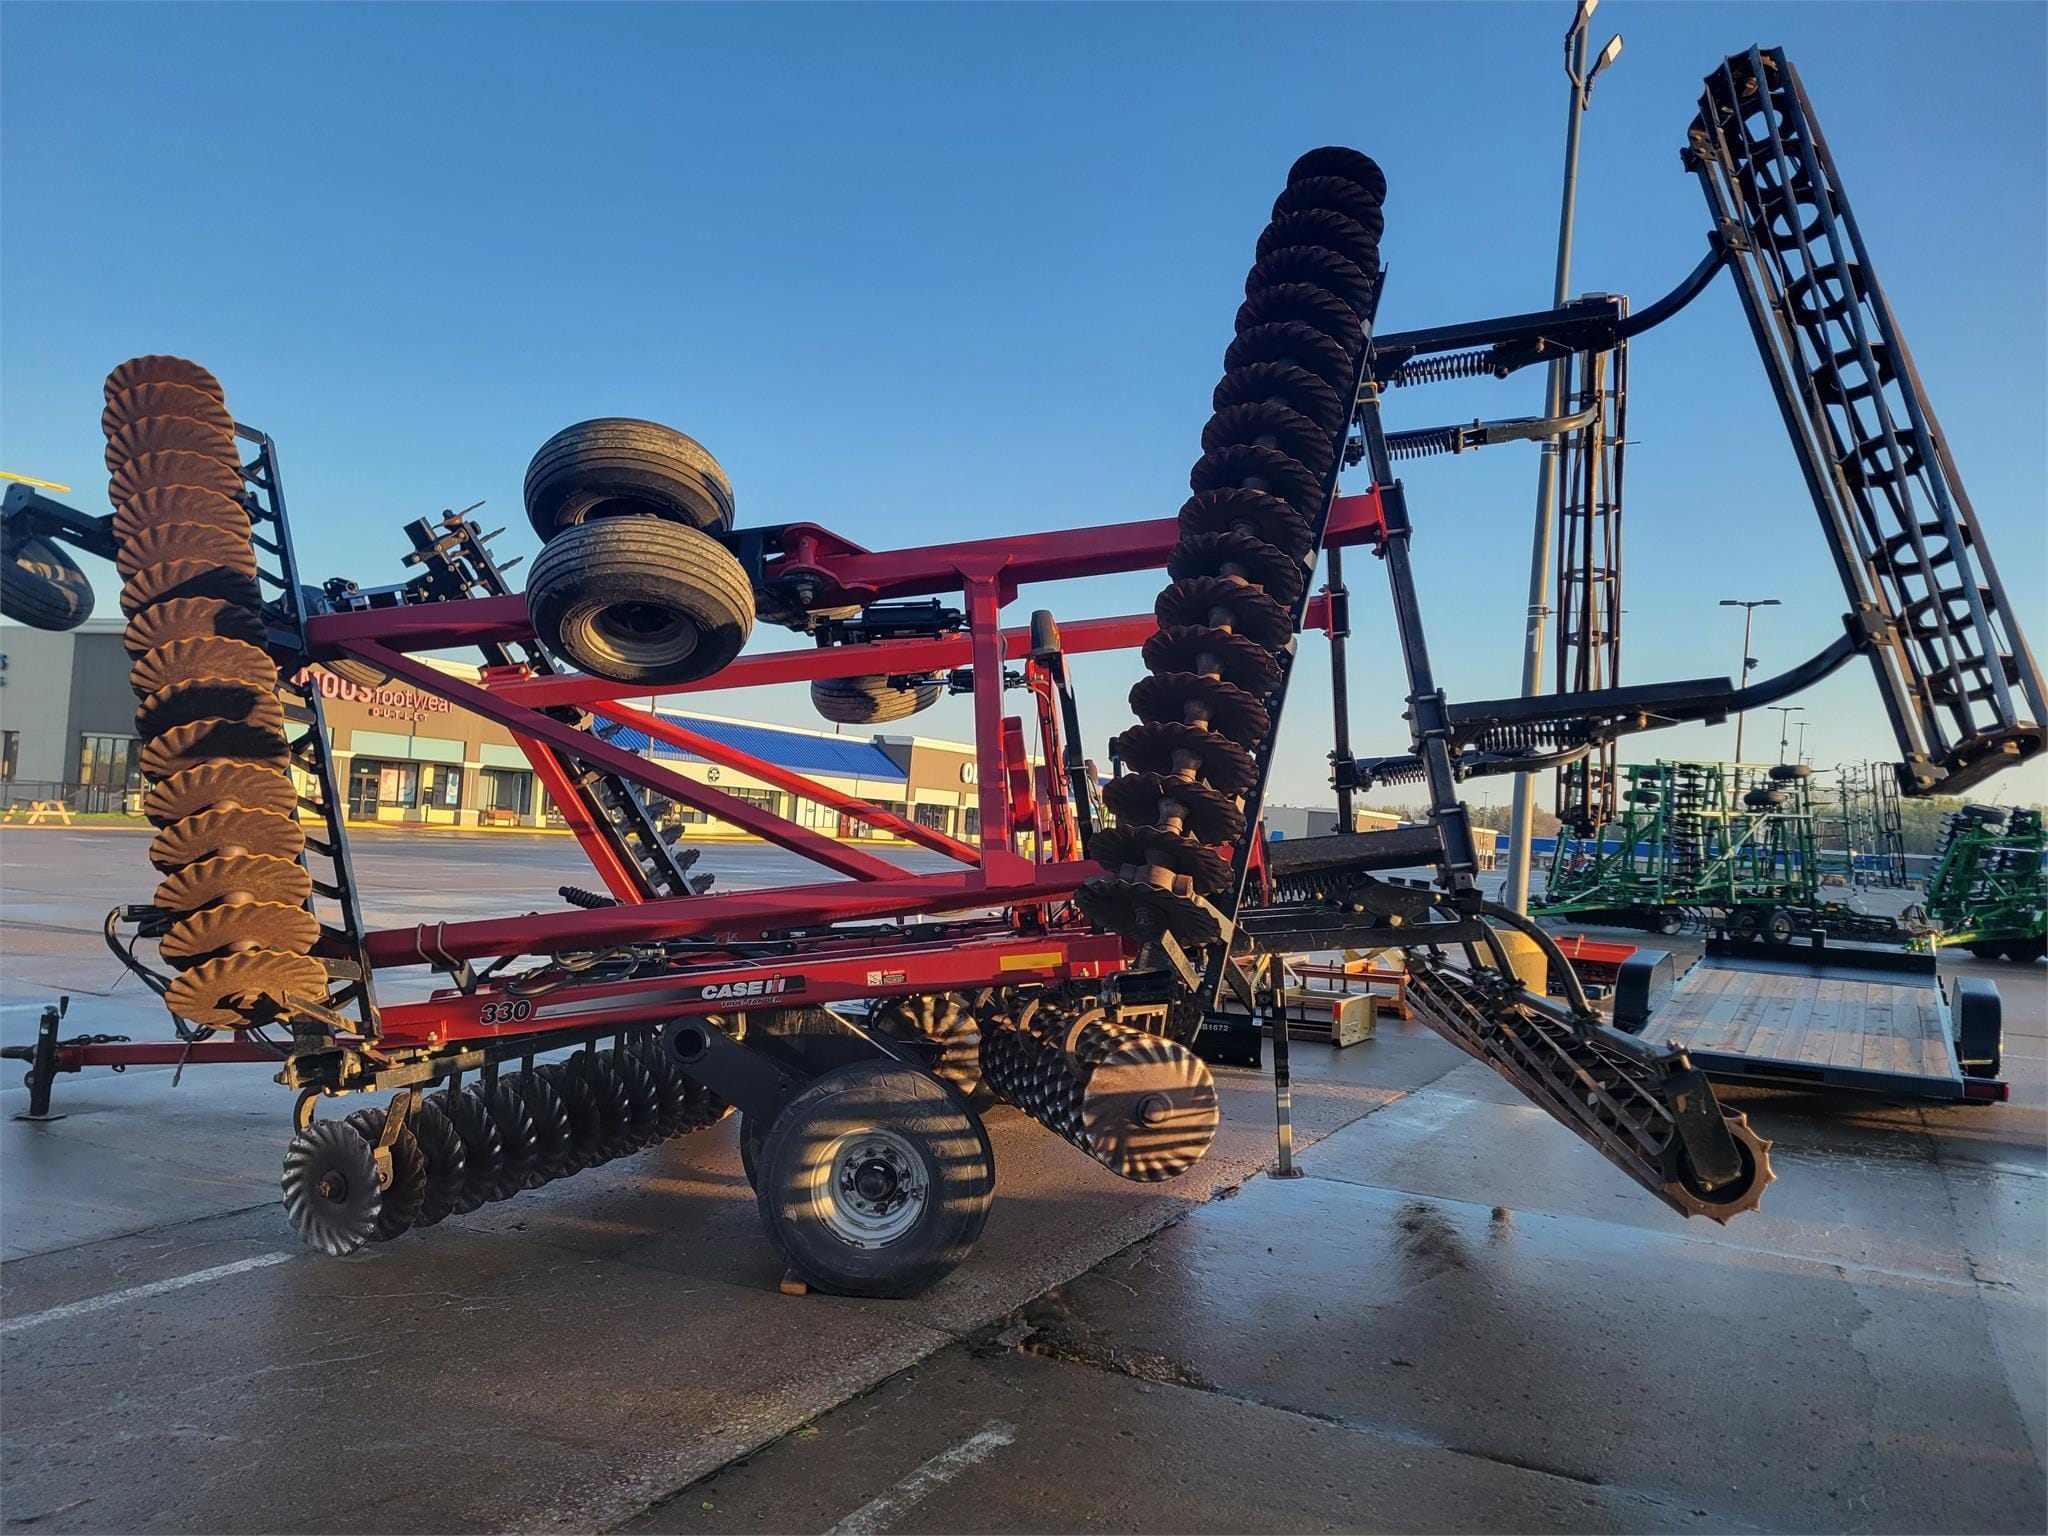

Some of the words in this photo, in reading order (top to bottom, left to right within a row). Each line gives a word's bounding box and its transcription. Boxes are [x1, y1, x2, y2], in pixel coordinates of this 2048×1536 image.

[277, 666, 373, 703] MOUS
[371, 707, 430, 723] OUTLET
[961, 762, 978, 784] OL
[701, 981, 764, 1000] CASE
[480, 1000, 531, 1025] 330
[1201, 1023, 1229, 1032] B1672
